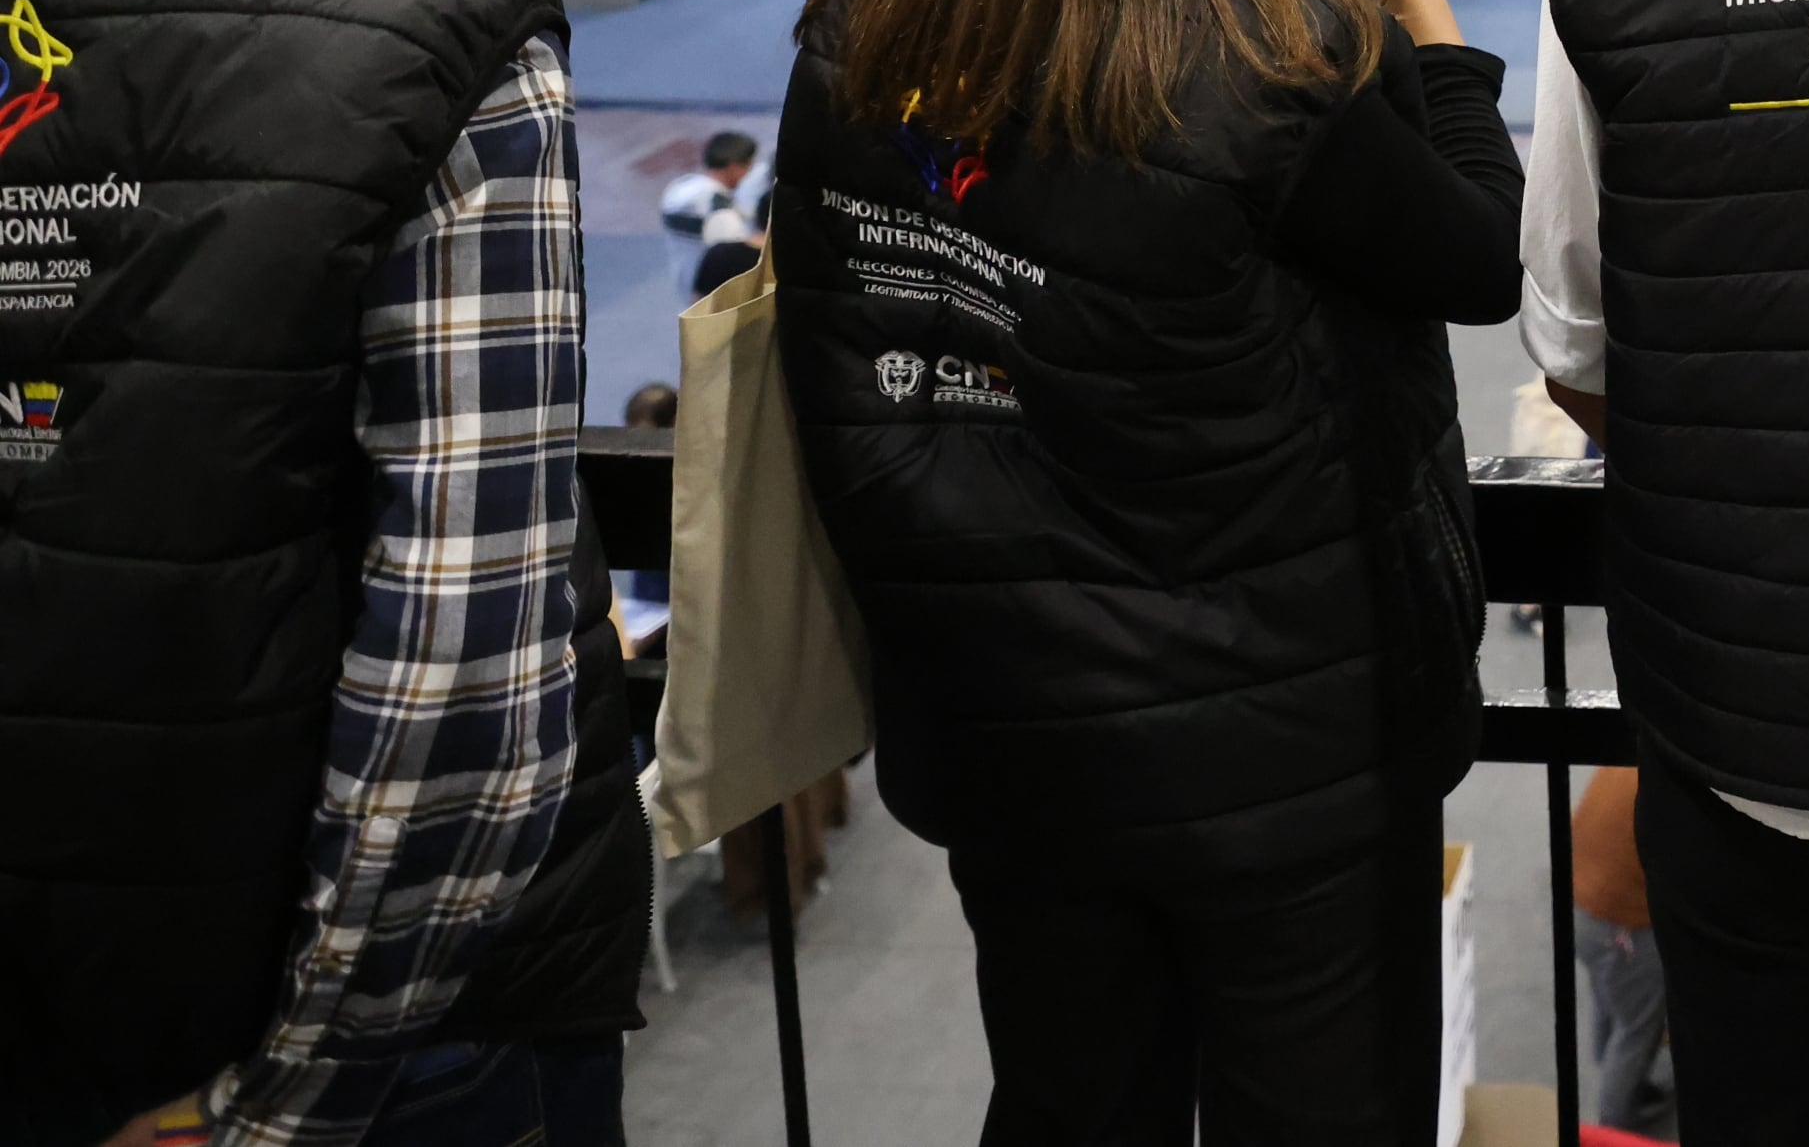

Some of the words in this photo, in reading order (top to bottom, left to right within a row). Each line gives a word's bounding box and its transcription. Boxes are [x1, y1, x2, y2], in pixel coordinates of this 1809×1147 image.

[0, 172, 141, 211] ERVACIÓN
[895, 207, 925, 227] DE
[858, 223, 1006, 288] INTERNACIONAL
[0, 260, 41, 281] MBIA
[44, 258, 92, 279] 2026
[847, 257, 935, 280] ELECCIONES
[0, 293, 75, 310] SPARENCIA
[864, 283, 939, 301] LEGITIMIDAD
[942, 292, 950, 303] Y
